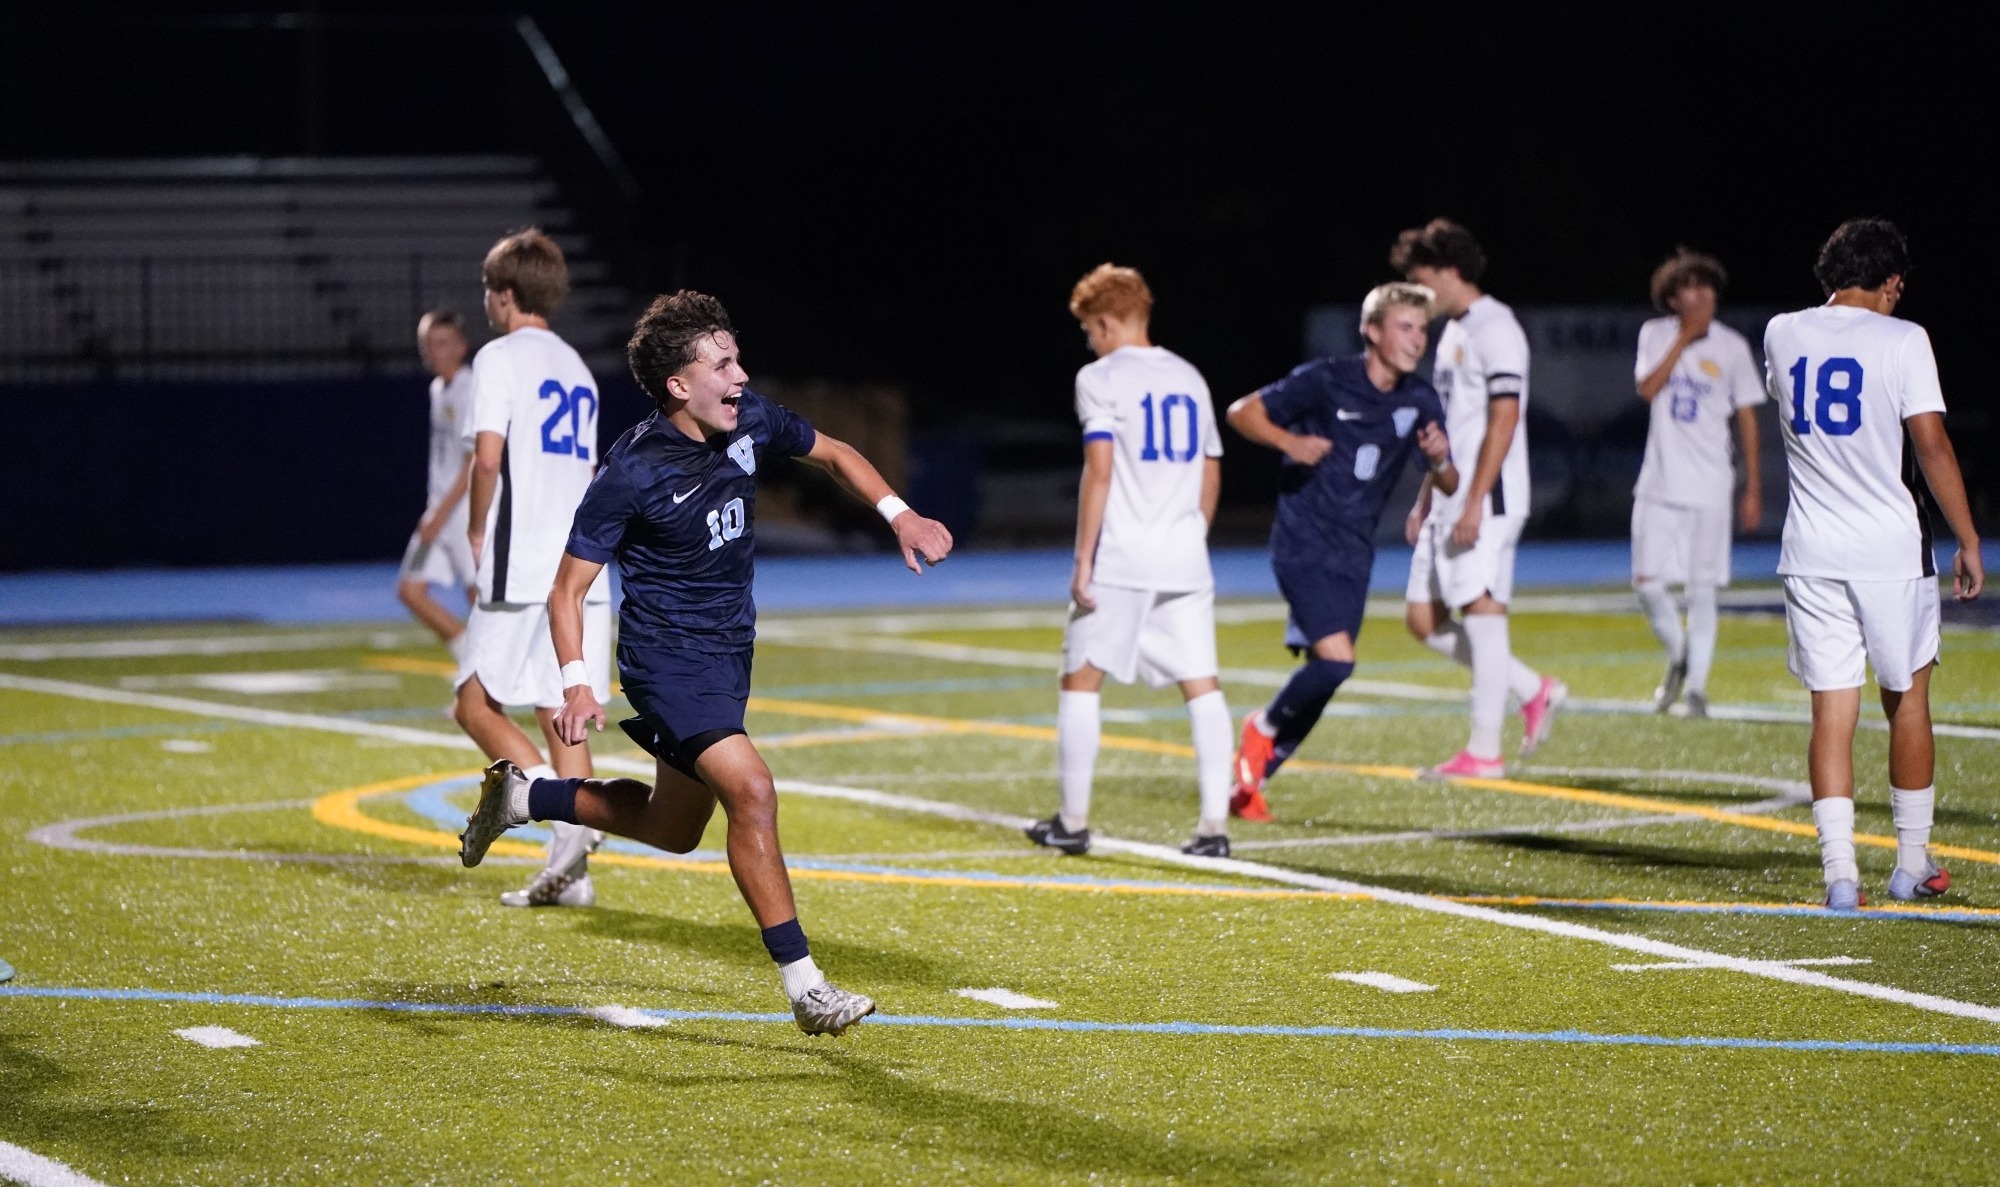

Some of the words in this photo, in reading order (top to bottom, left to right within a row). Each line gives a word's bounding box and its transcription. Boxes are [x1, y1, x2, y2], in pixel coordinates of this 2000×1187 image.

[538, 379, 597, 461] 20
[1141, 392, 1198, 462] 10
[1789, 356, 1864, 435] 18
[727, 434, 755, 476] V
[706, 497, 745, 551] 10
